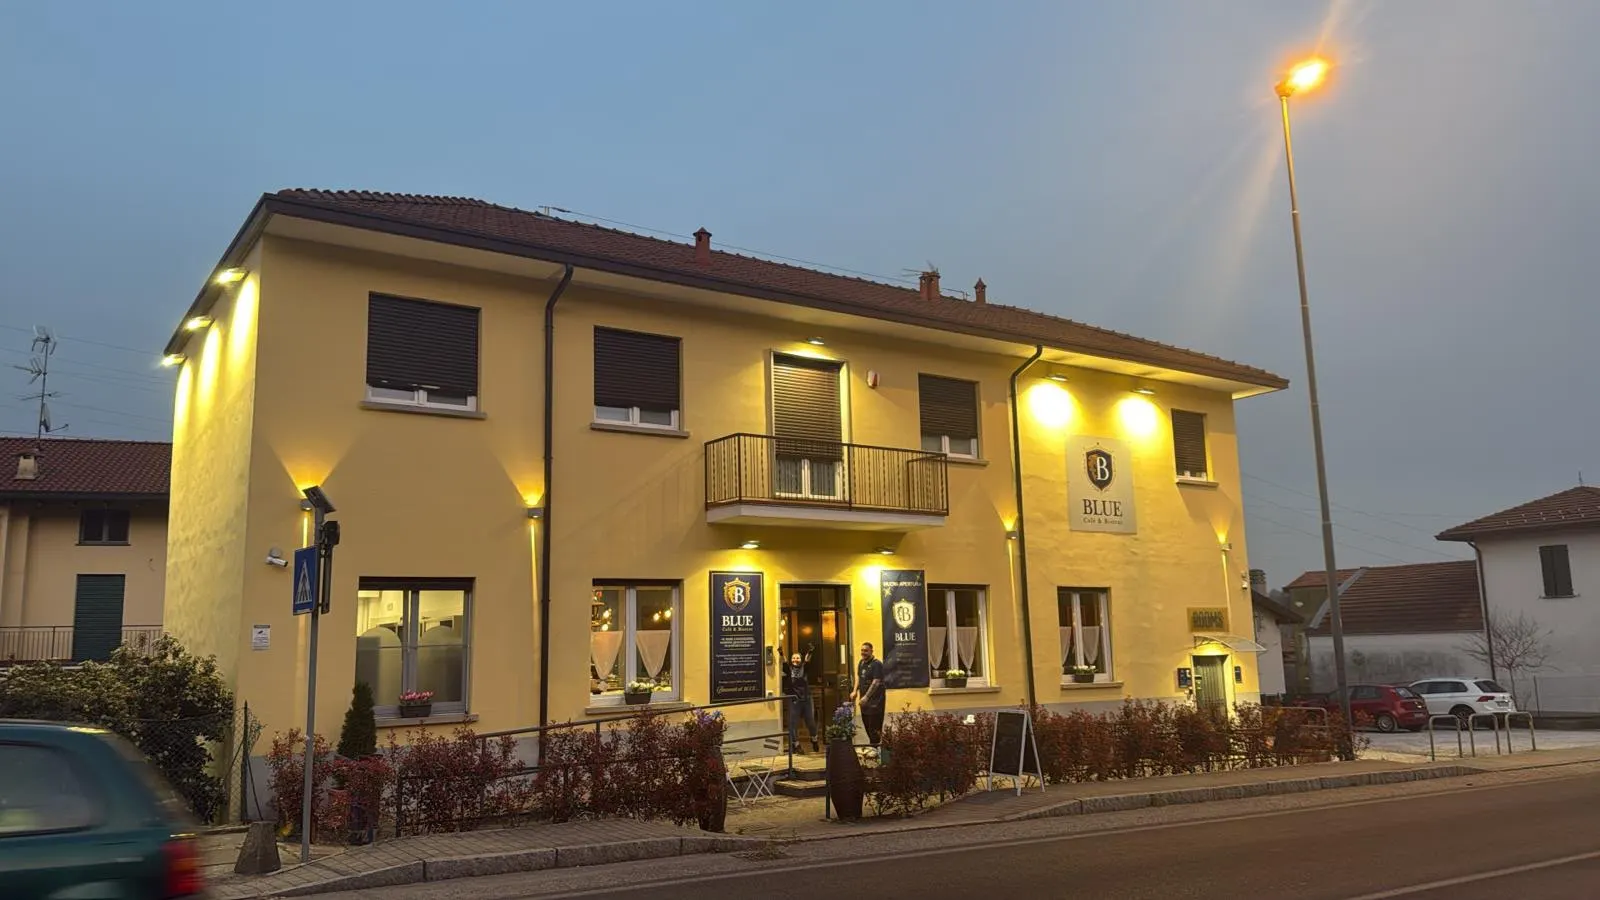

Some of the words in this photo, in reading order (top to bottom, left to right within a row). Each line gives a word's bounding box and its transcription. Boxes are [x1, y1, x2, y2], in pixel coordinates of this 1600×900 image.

[1096, 456, 1110, 481] B
[1082, 498, 1123, 517] BLUE
[734, 586, 745, 604] B
[722, 615, 754, 627] BLUE
[902, 606, 911, 621] B
[1192, 611, 1225, 629] ROOMS
[894, 631, 917, 642] BLUE
